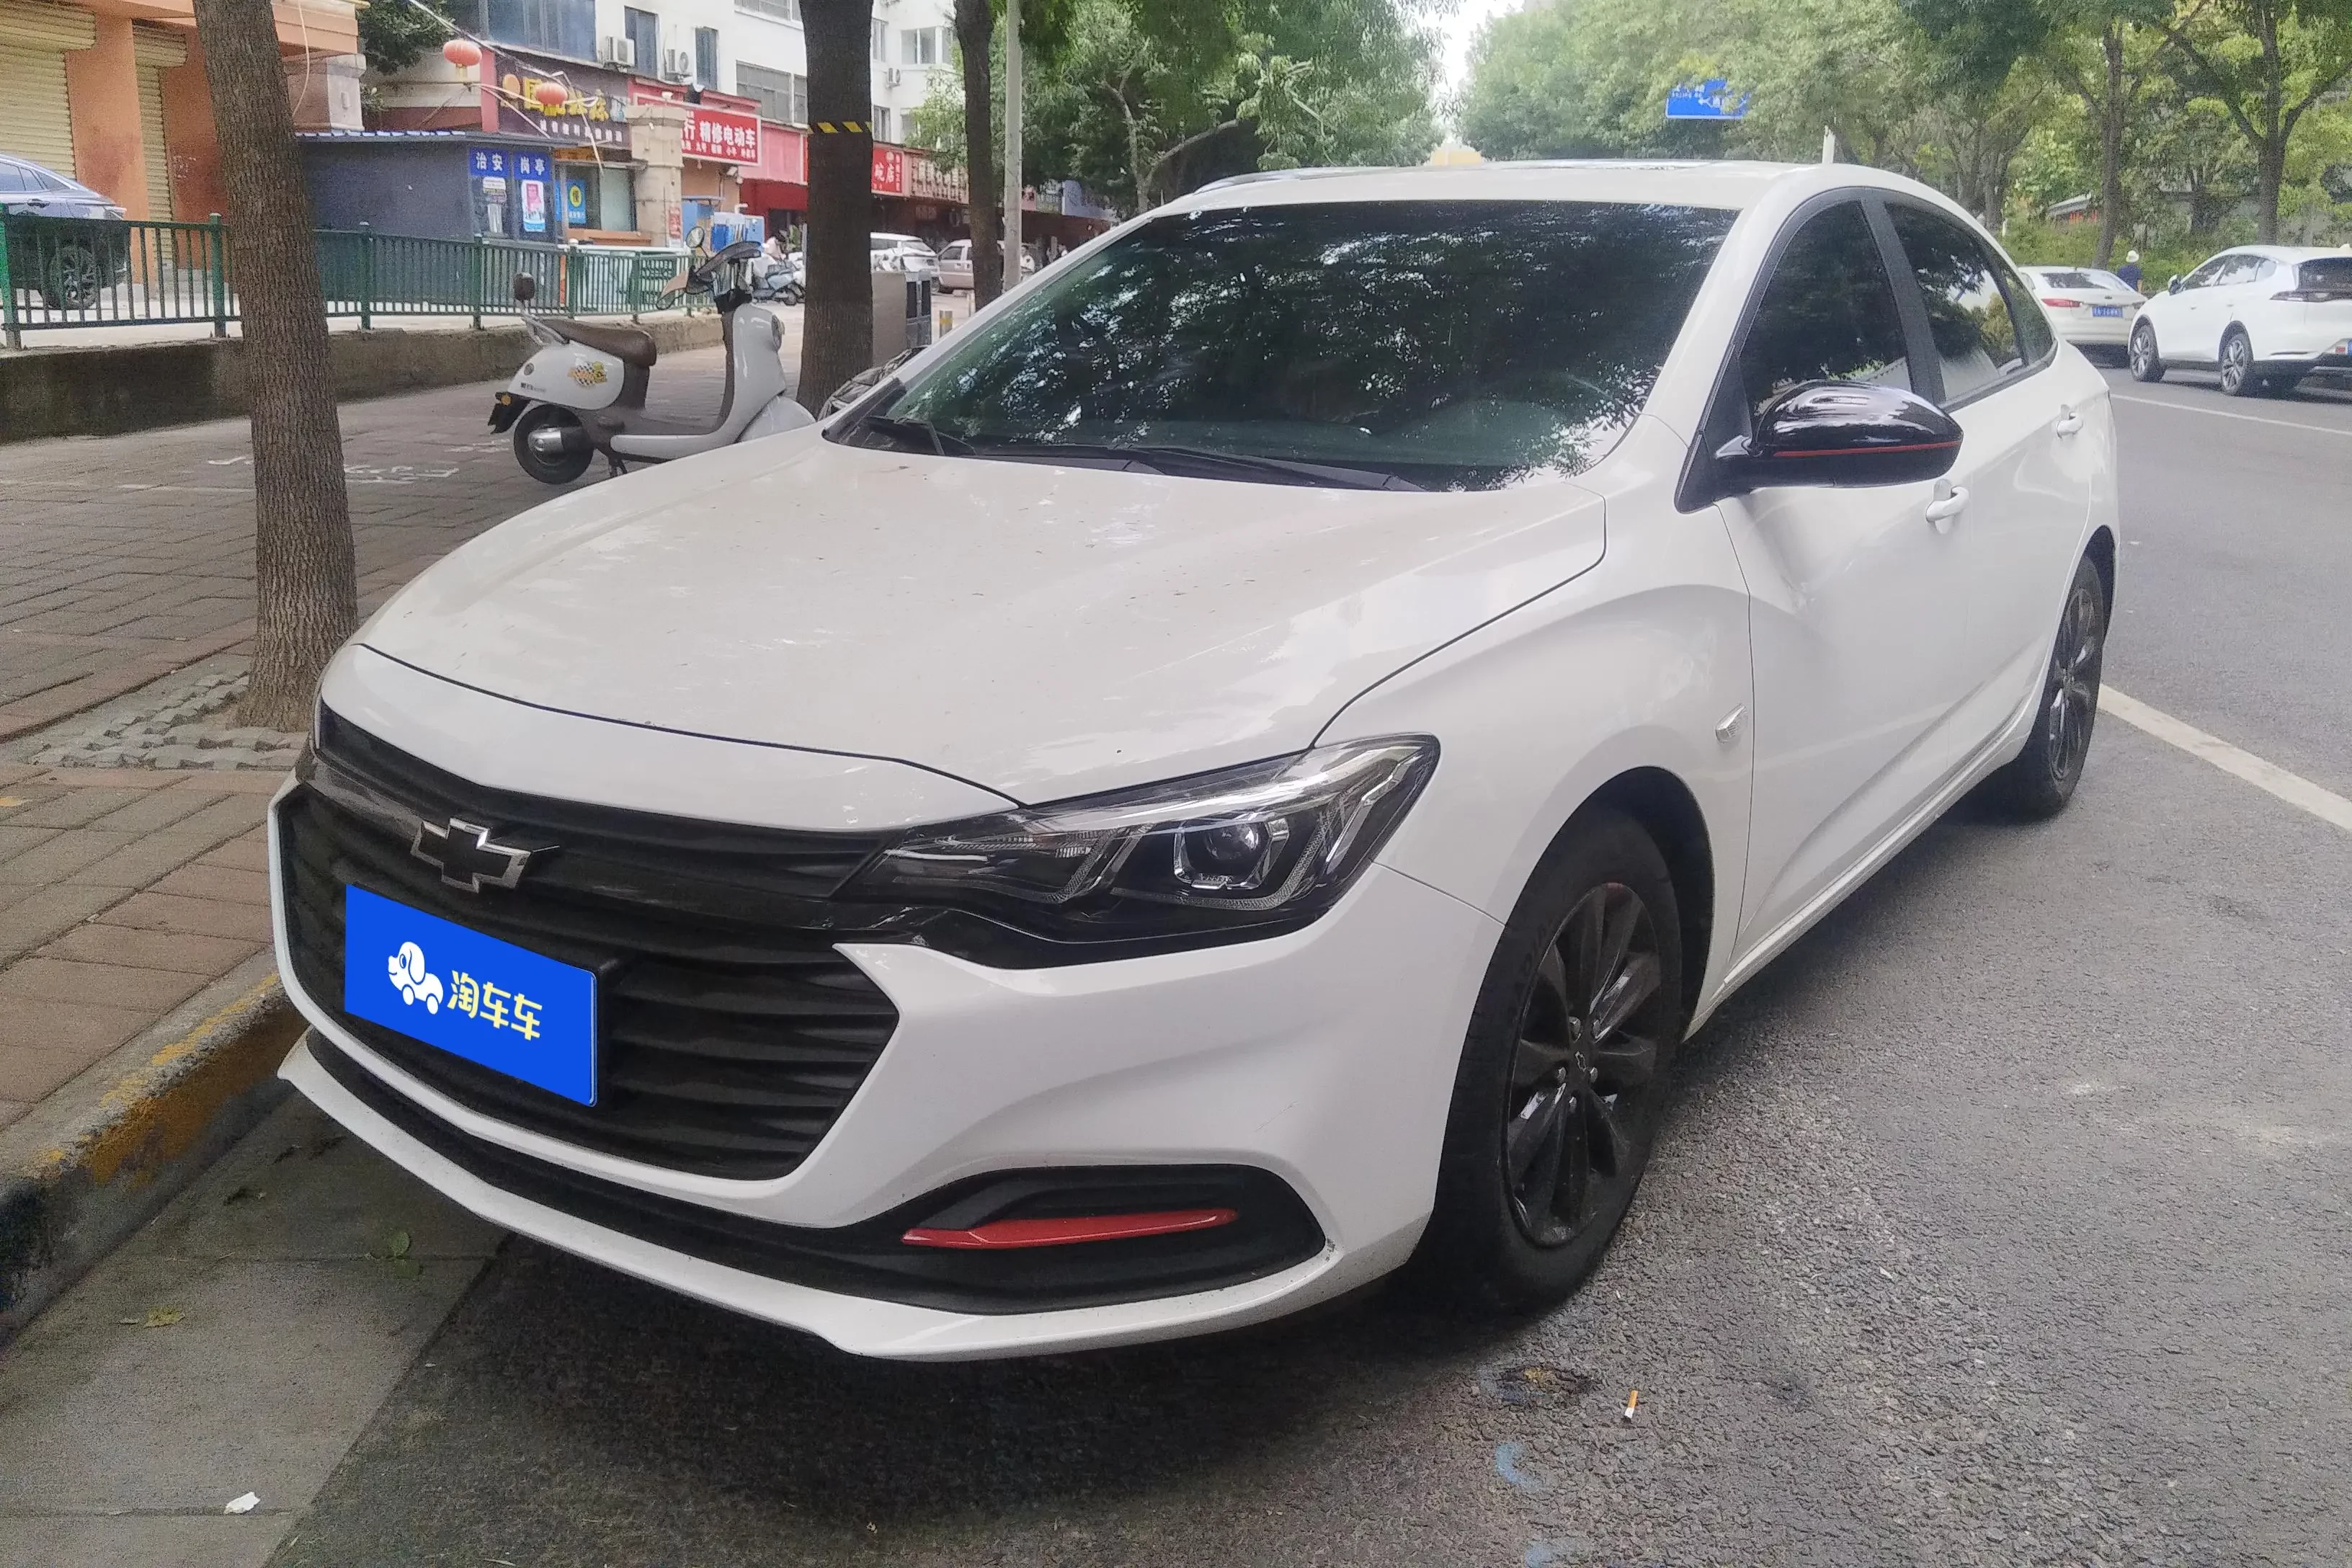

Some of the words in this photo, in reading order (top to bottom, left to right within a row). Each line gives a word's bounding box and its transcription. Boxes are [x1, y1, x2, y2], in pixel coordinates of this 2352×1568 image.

[700, 120, 756, 149] 精修电动车
[476, 151, 504, 172] 治安
[520, 156, 545, 176] 岗亭
